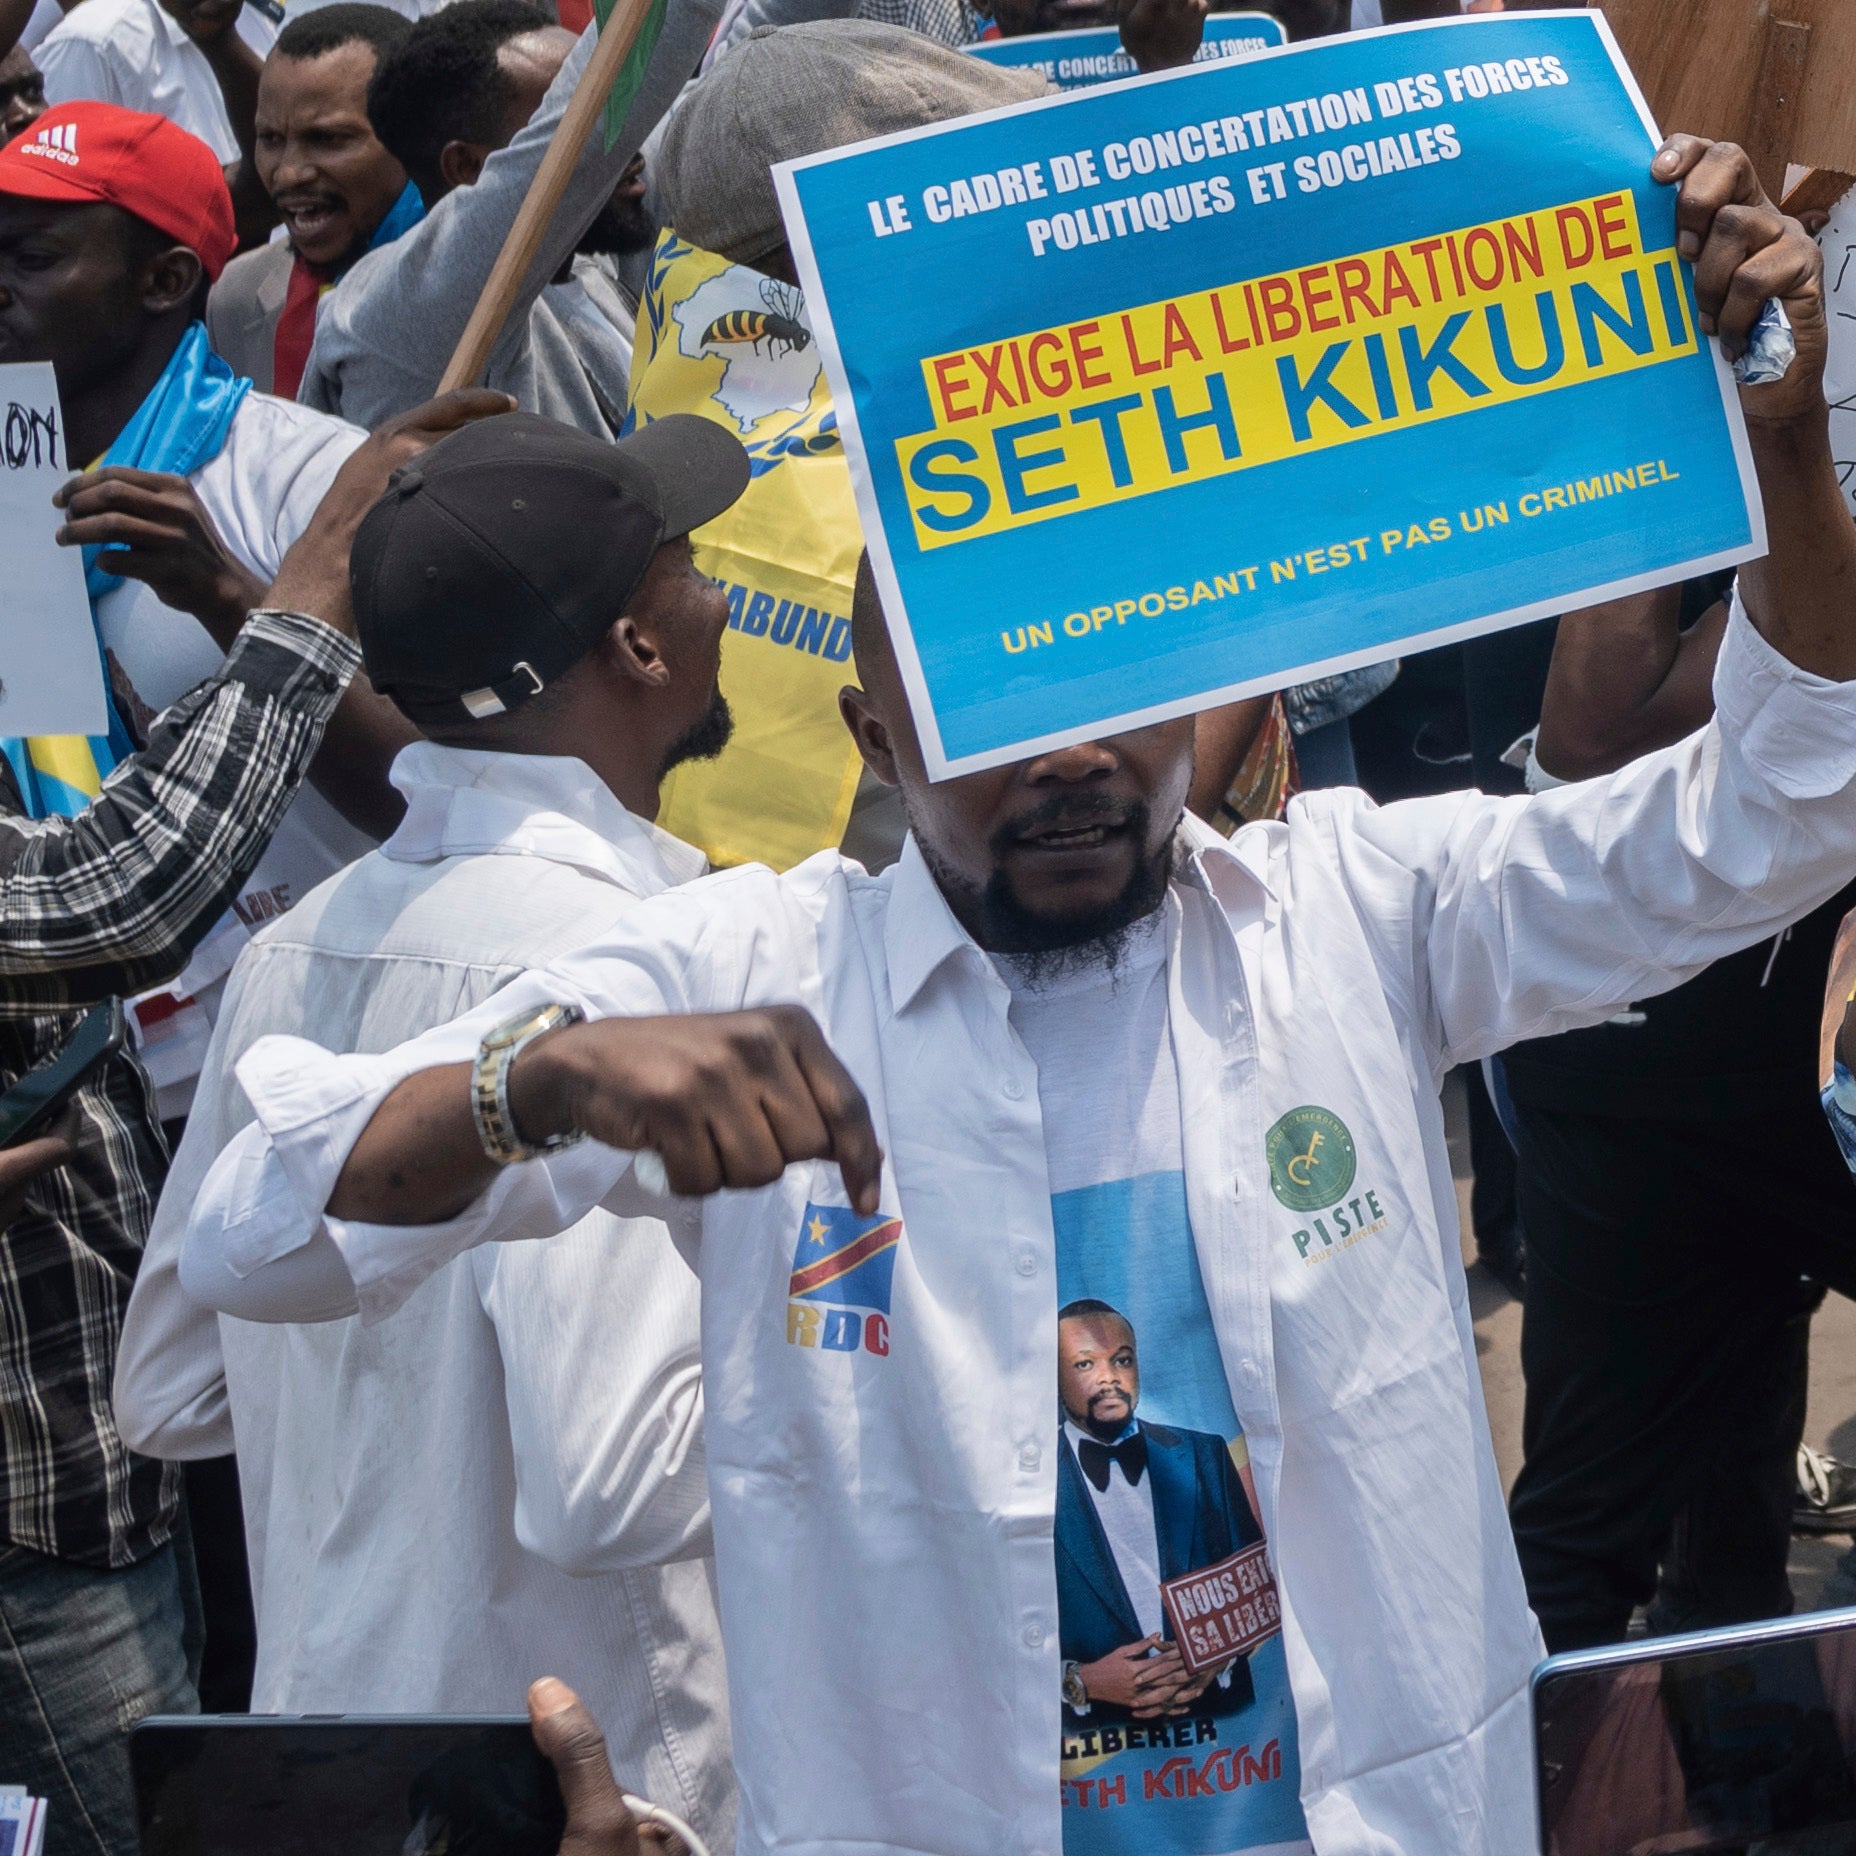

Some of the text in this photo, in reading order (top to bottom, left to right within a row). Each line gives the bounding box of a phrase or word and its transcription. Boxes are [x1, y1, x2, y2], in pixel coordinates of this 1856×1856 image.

[21, 140, 79, 167] adidas
[867, 55, 1570, 238] LE CADRE DE CONCERTATION DES FORCES
[1027, 124, 1462, 257] POLITIQUES ET SOCIALES
[932, 195, 1633, 424] EXIGE LA LIBERATION DE
[908, 380, 1242, 534] SETH
[1277, 261, 1693, 444] KIKUNI
[1001, 458, 1680, 656] UN OPPOSANT N'EST PAS UN CRIMINEL
[1292, 1190, 1384, 1259] PISTE
[1304, 1249, 1332, 1267] POUR
[786, 1301, 891, 1357] RDC
[1176, 1571, 1239, 1622] NOUS
[1188, 1622, 1225, 1655] SA
[1062, 1718, 1218, 1760] LIBERER
[1144, 1738, 1282, 1800] KIKUNI
